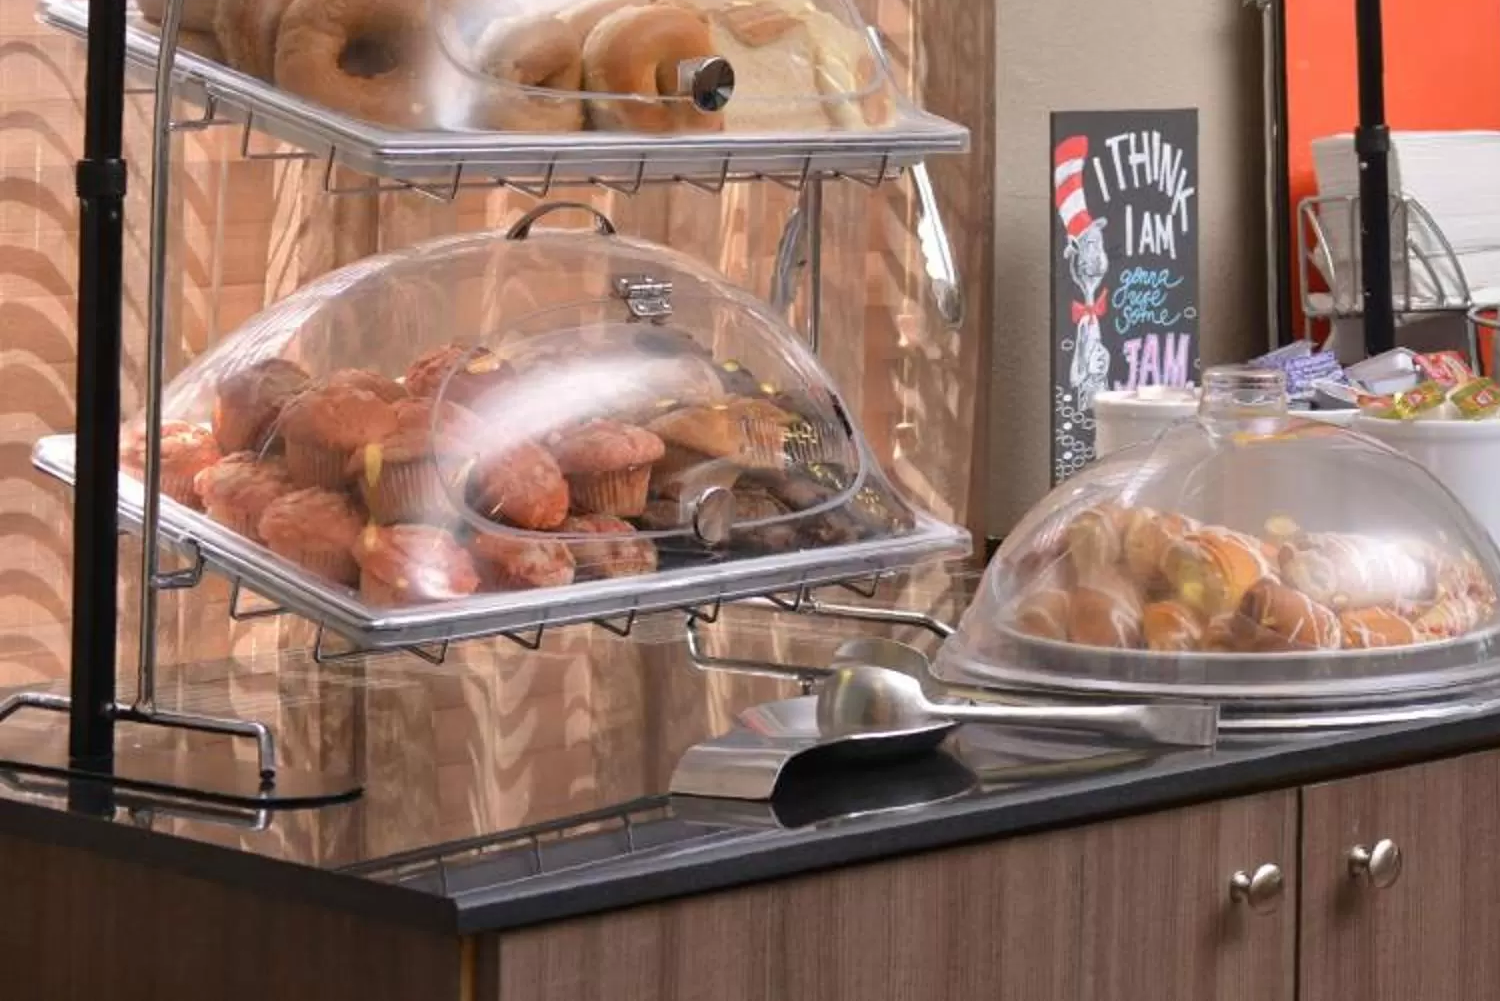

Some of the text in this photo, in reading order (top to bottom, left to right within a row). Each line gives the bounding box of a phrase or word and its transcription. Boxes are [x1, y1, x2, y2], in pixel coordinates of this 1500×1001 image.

[1092, 129, 1196, 234] I THINK
[1124, 203, 1177, 260] I AM
